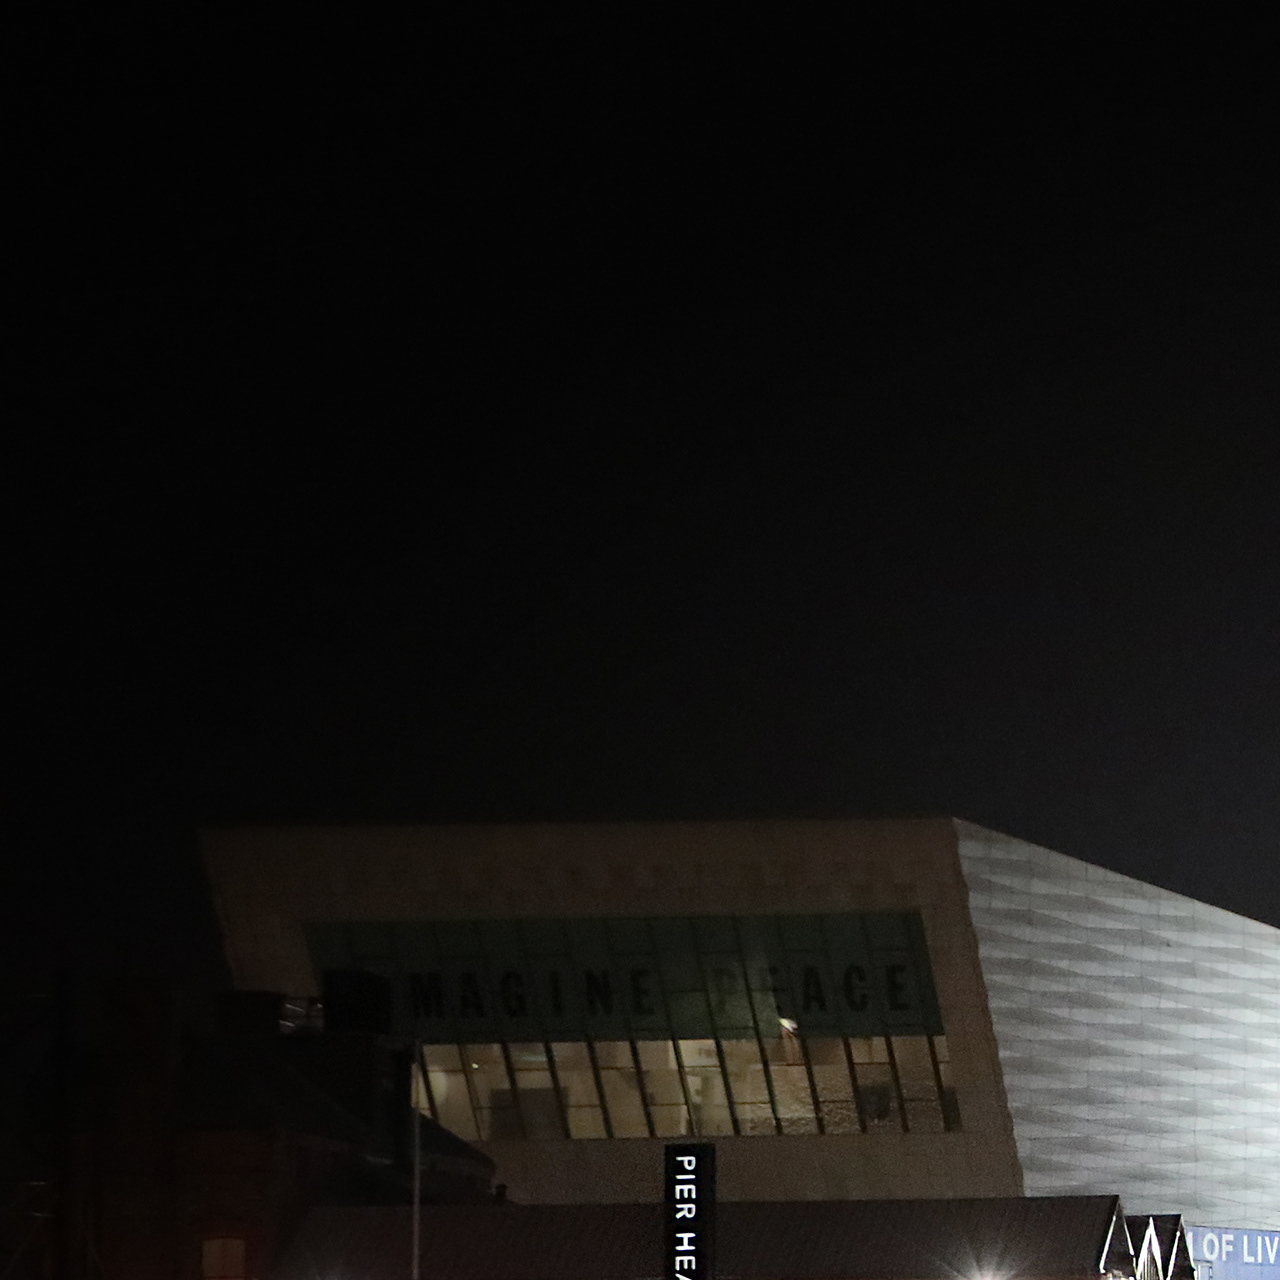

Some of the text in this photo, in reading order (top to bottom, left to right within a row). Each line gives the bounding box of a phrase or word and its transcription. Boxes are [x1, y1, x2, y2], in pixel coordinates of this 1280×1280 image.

[409, 968, 656, 1019] MAGINE
[675, 1155, 696, 1219] PIER
[1202, 1232, 1234, 1262] OF
